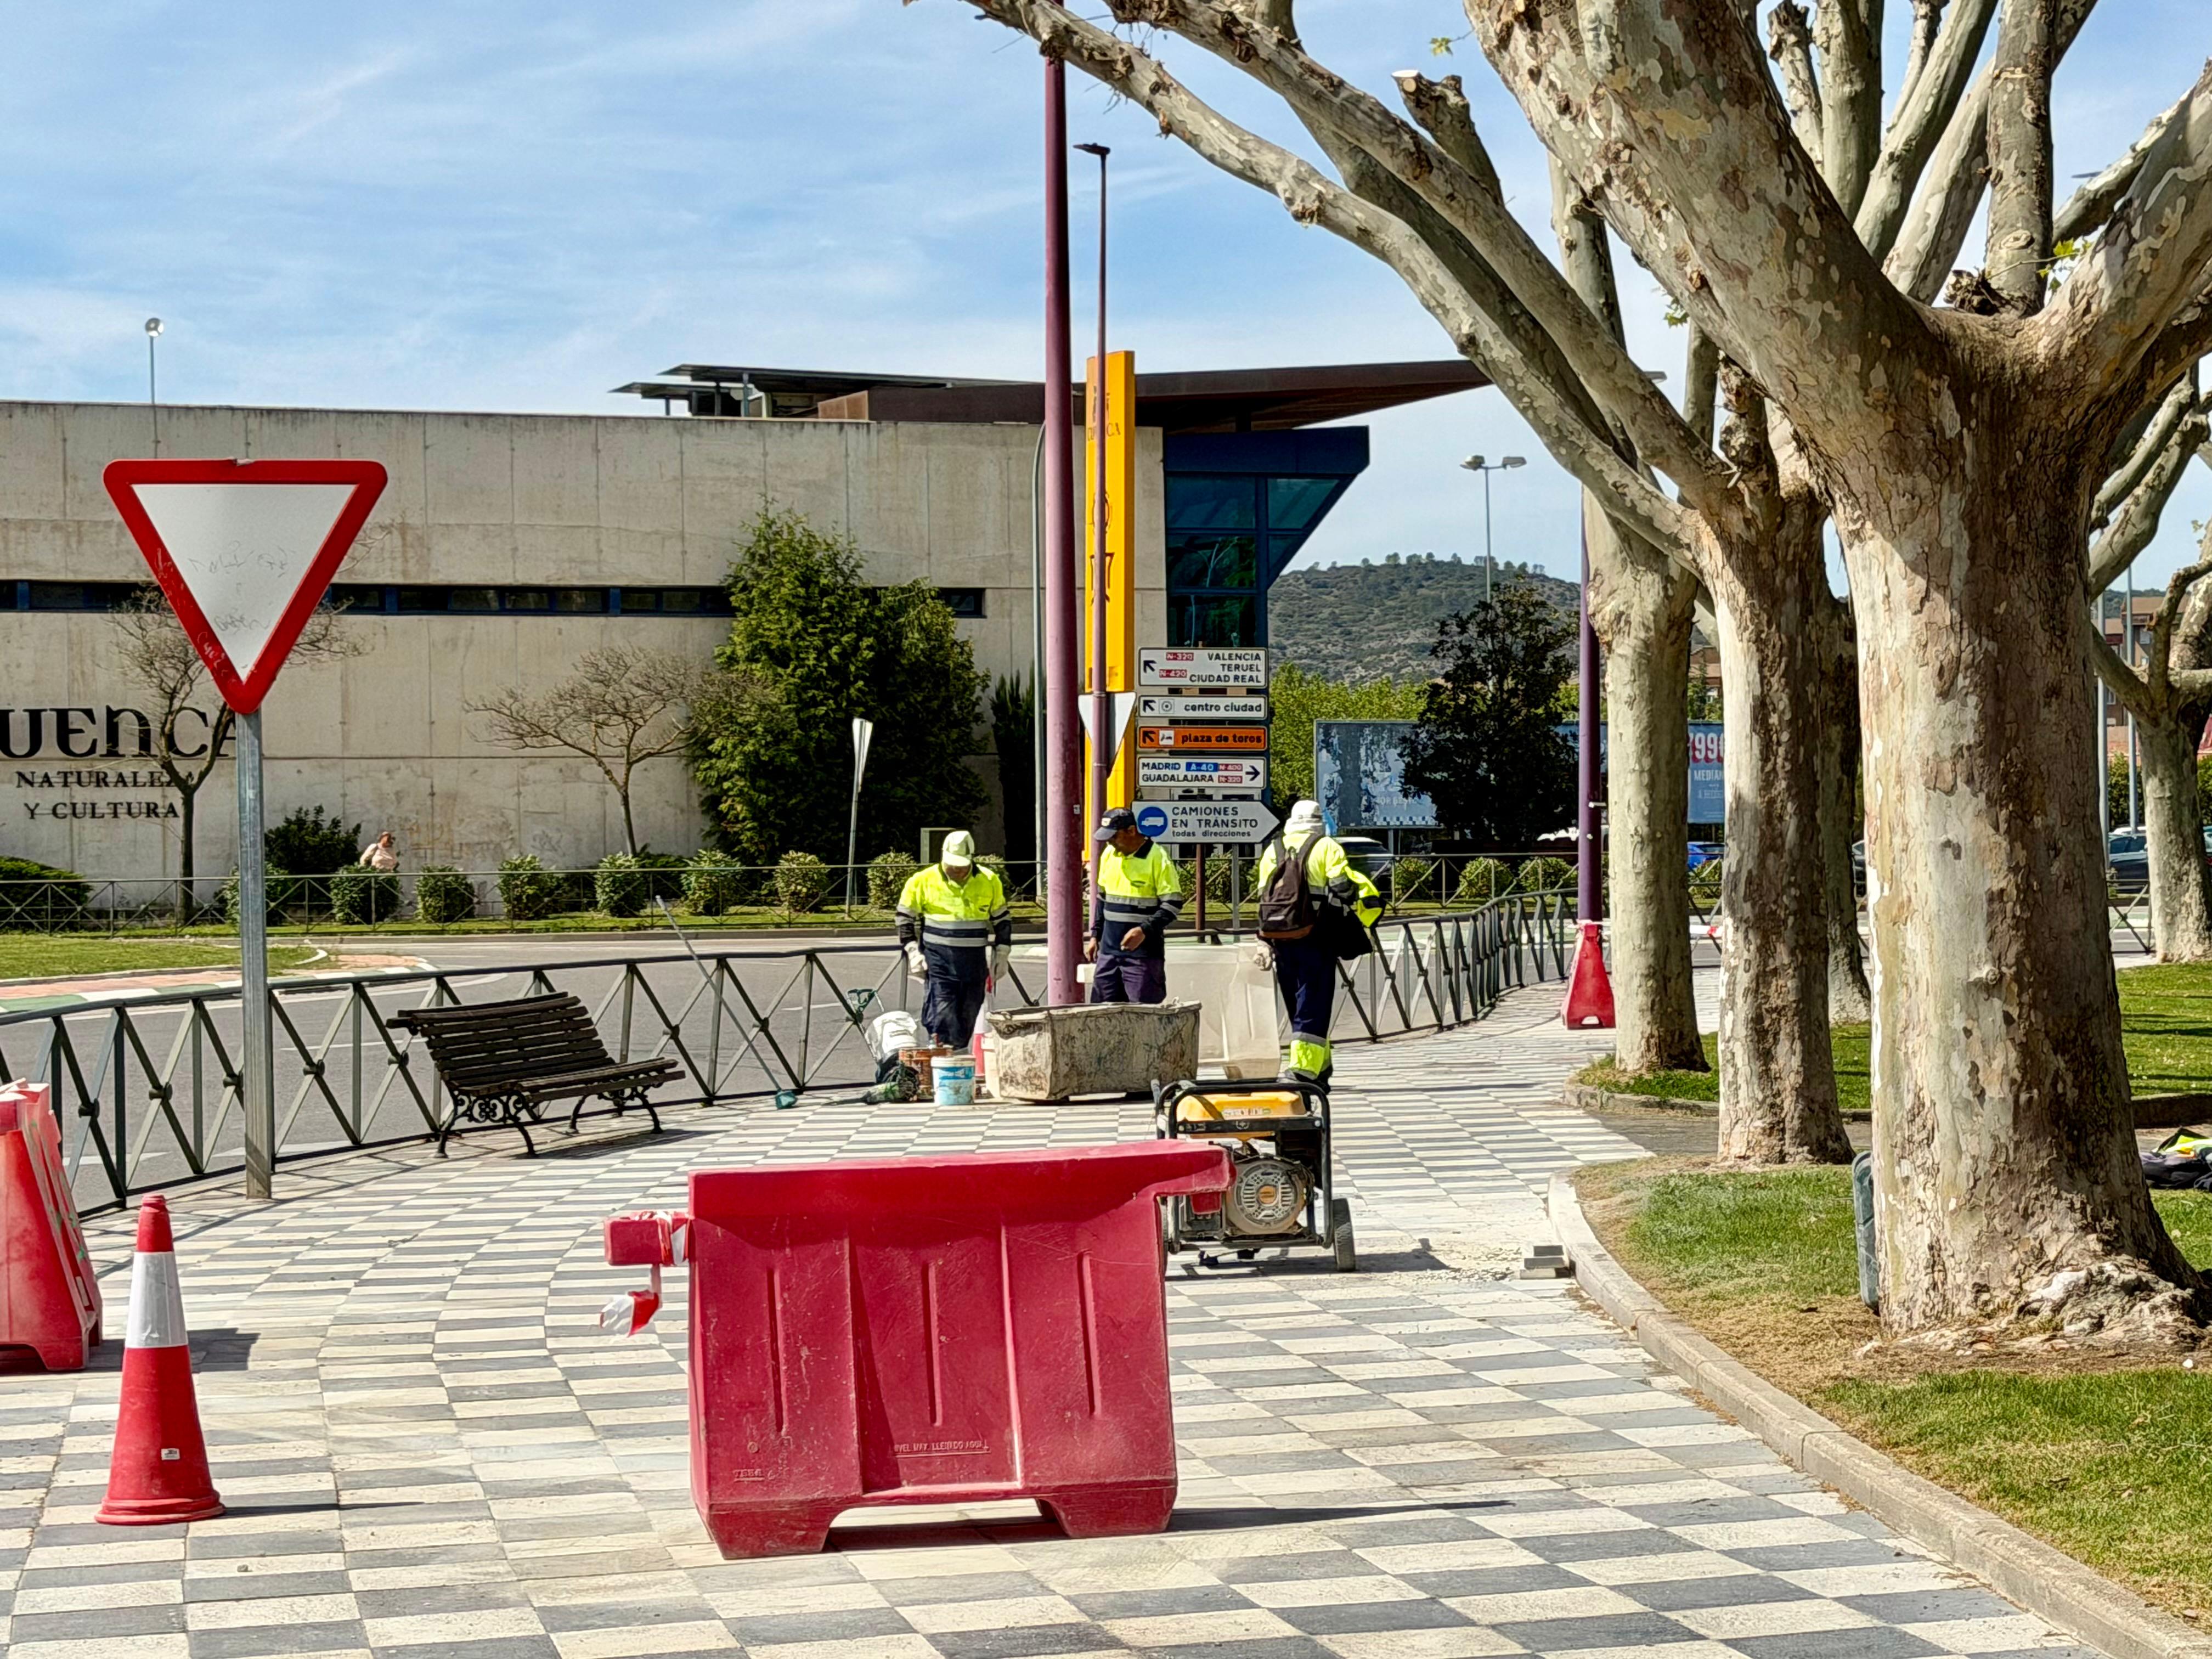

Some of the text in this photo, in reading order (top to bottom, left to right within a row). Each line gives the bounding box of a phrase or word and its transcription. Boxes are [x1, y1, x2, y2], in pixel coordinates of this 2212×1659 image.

[1207, 652, 1261, 661] VALENCIA
[1220, 663, 1261, 672] TERUEL
[1189, 674, 1261, 683] CIUDAD REAL
[1184, 702, 1262, 712] centro ciudad
[1181, 733, 1262, 744] plaza de toros
[1142, 762, 1181, 770] MADRID
[1142, 774, 1214, 782] GUADALAJARA
[24, 802, 180, 819] Y CULTURA
[1171, 806, 1239, 816] CAMIONES
[1171, 816, 1259, 828] EN TRÁNSITO
